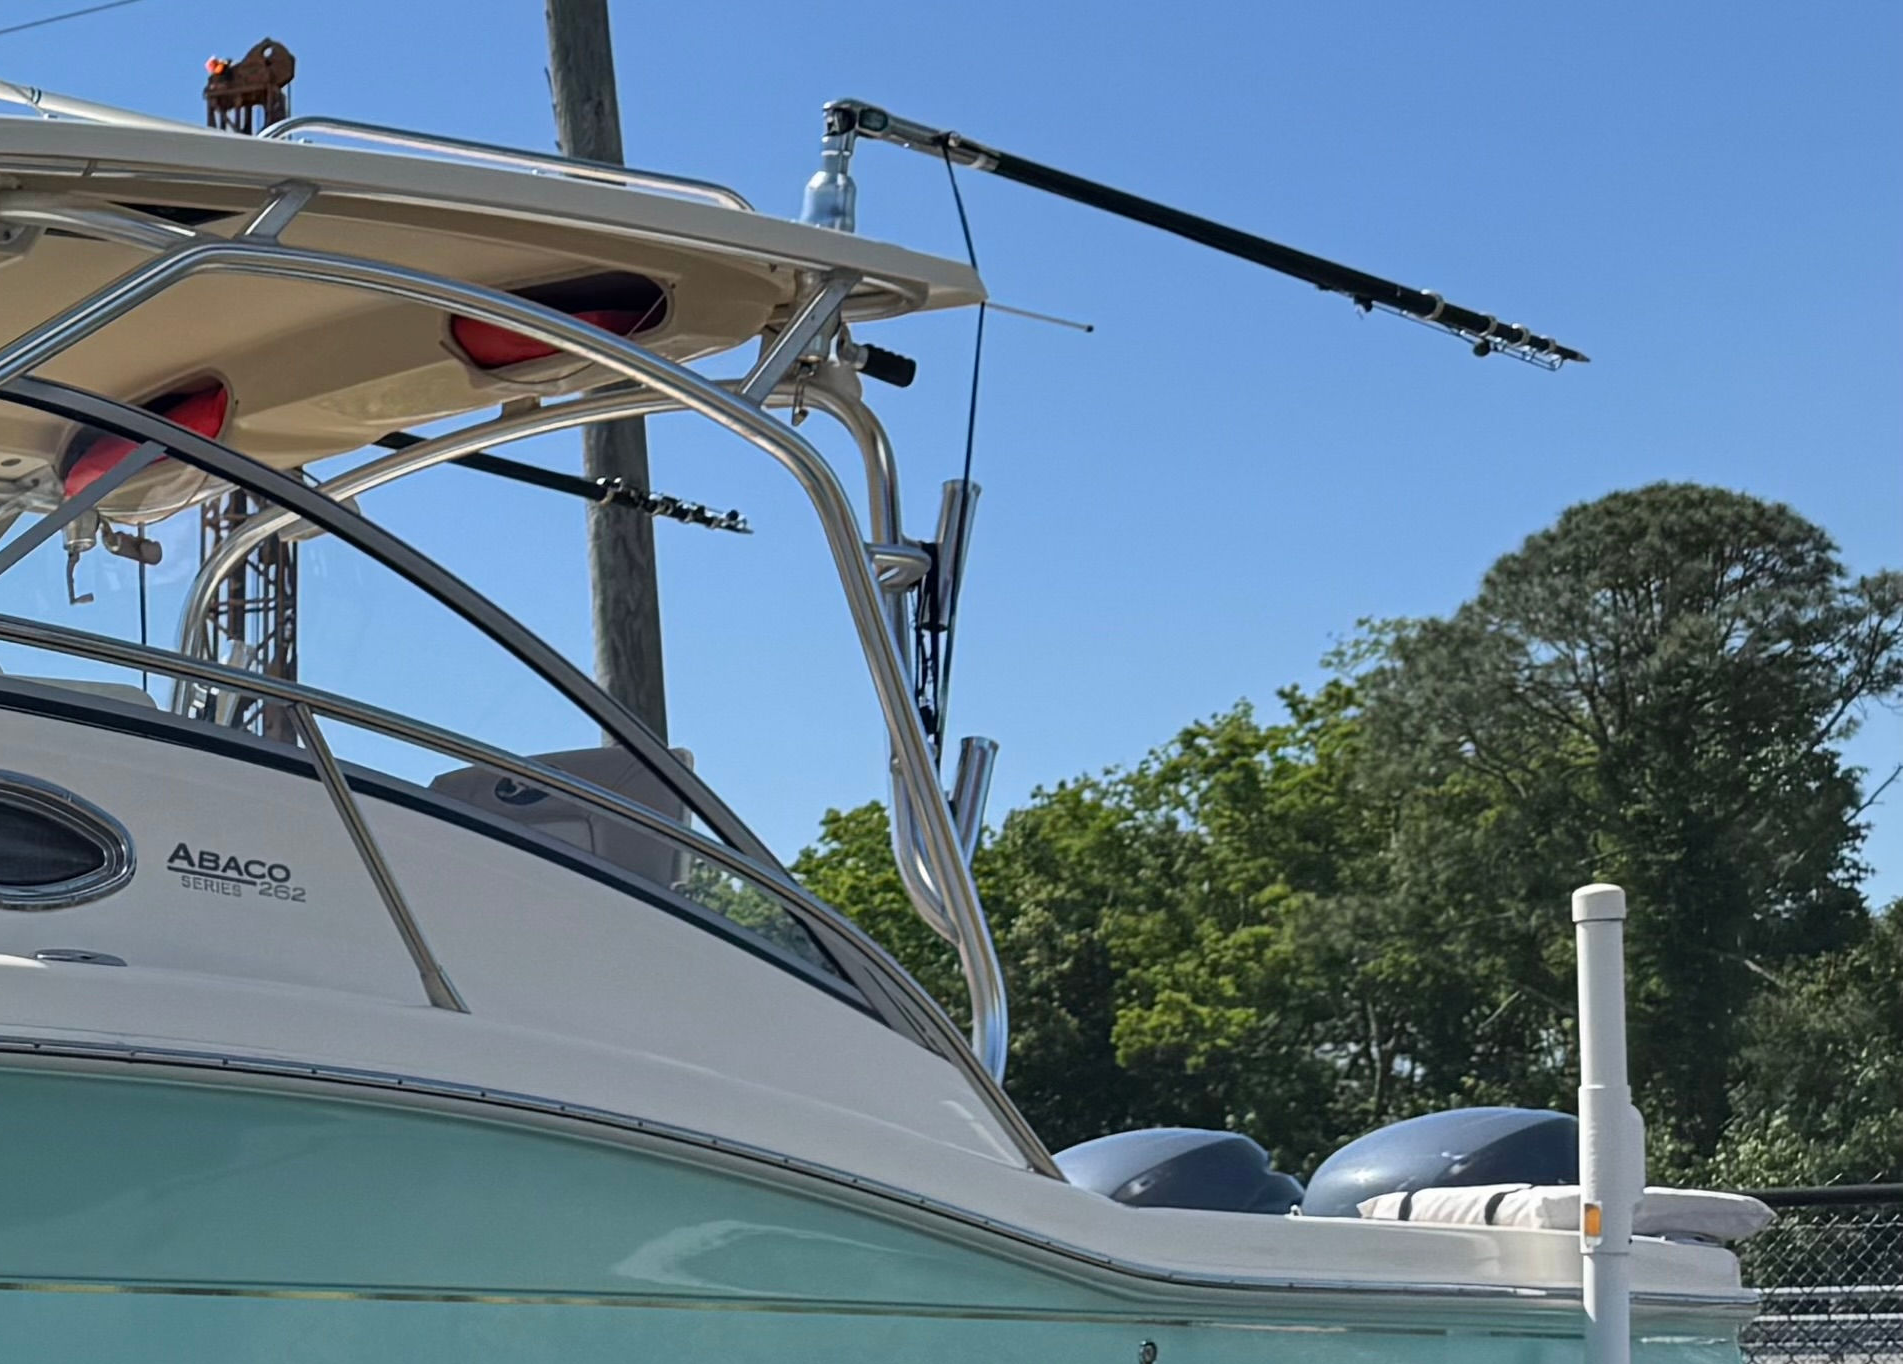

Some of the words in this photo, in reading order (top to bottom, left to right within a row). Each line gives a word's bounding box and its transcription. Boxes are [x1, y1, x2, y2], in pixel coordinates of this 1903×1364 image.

[167, 842, 291, 883] ABACO
[181, 874, 243, 898] SERIES
[258, 881, 307, 903] 262
